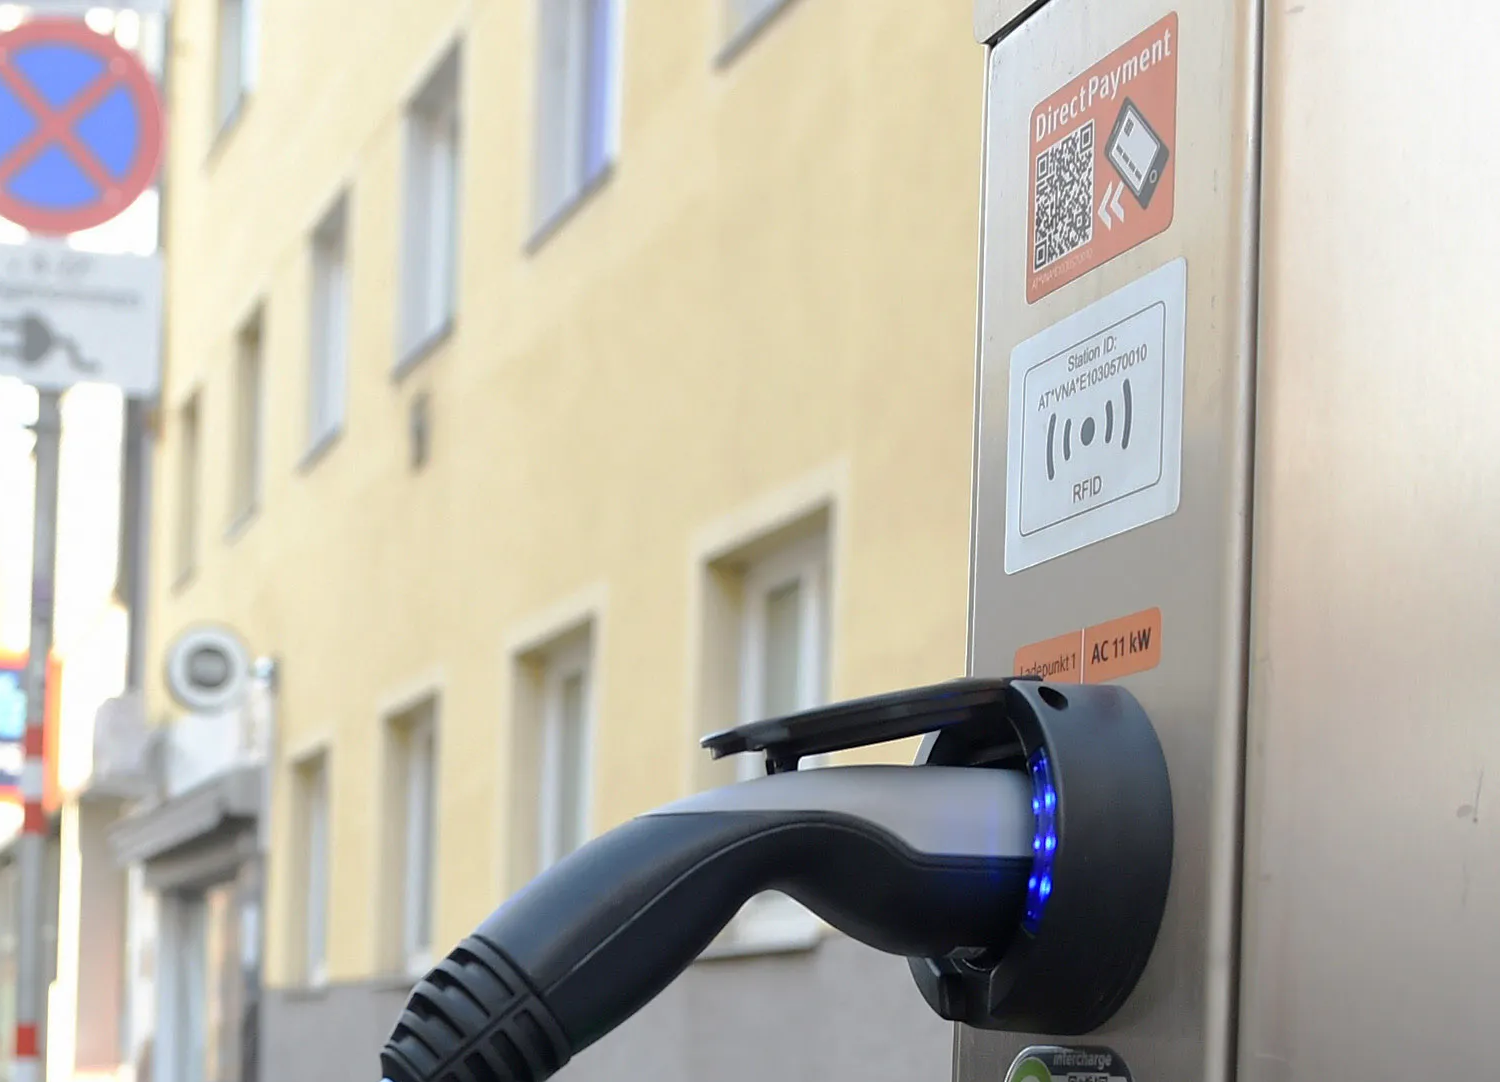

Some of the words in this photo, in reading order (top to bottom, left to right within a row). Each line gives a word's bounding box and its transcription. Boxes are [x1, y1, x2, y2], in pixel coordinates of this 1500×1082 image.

[1067, 345, 1100, 372] Station
[1103, 335, 1117, 355] ID:
[1072, 476, 1102, 504] RFID
[1071, 652, 1076, 669] 1
[1091, 640, 1109, 665] AC
[1112, 636, 1125, 659] 11
[1129, 627, 1151, 654] kW
